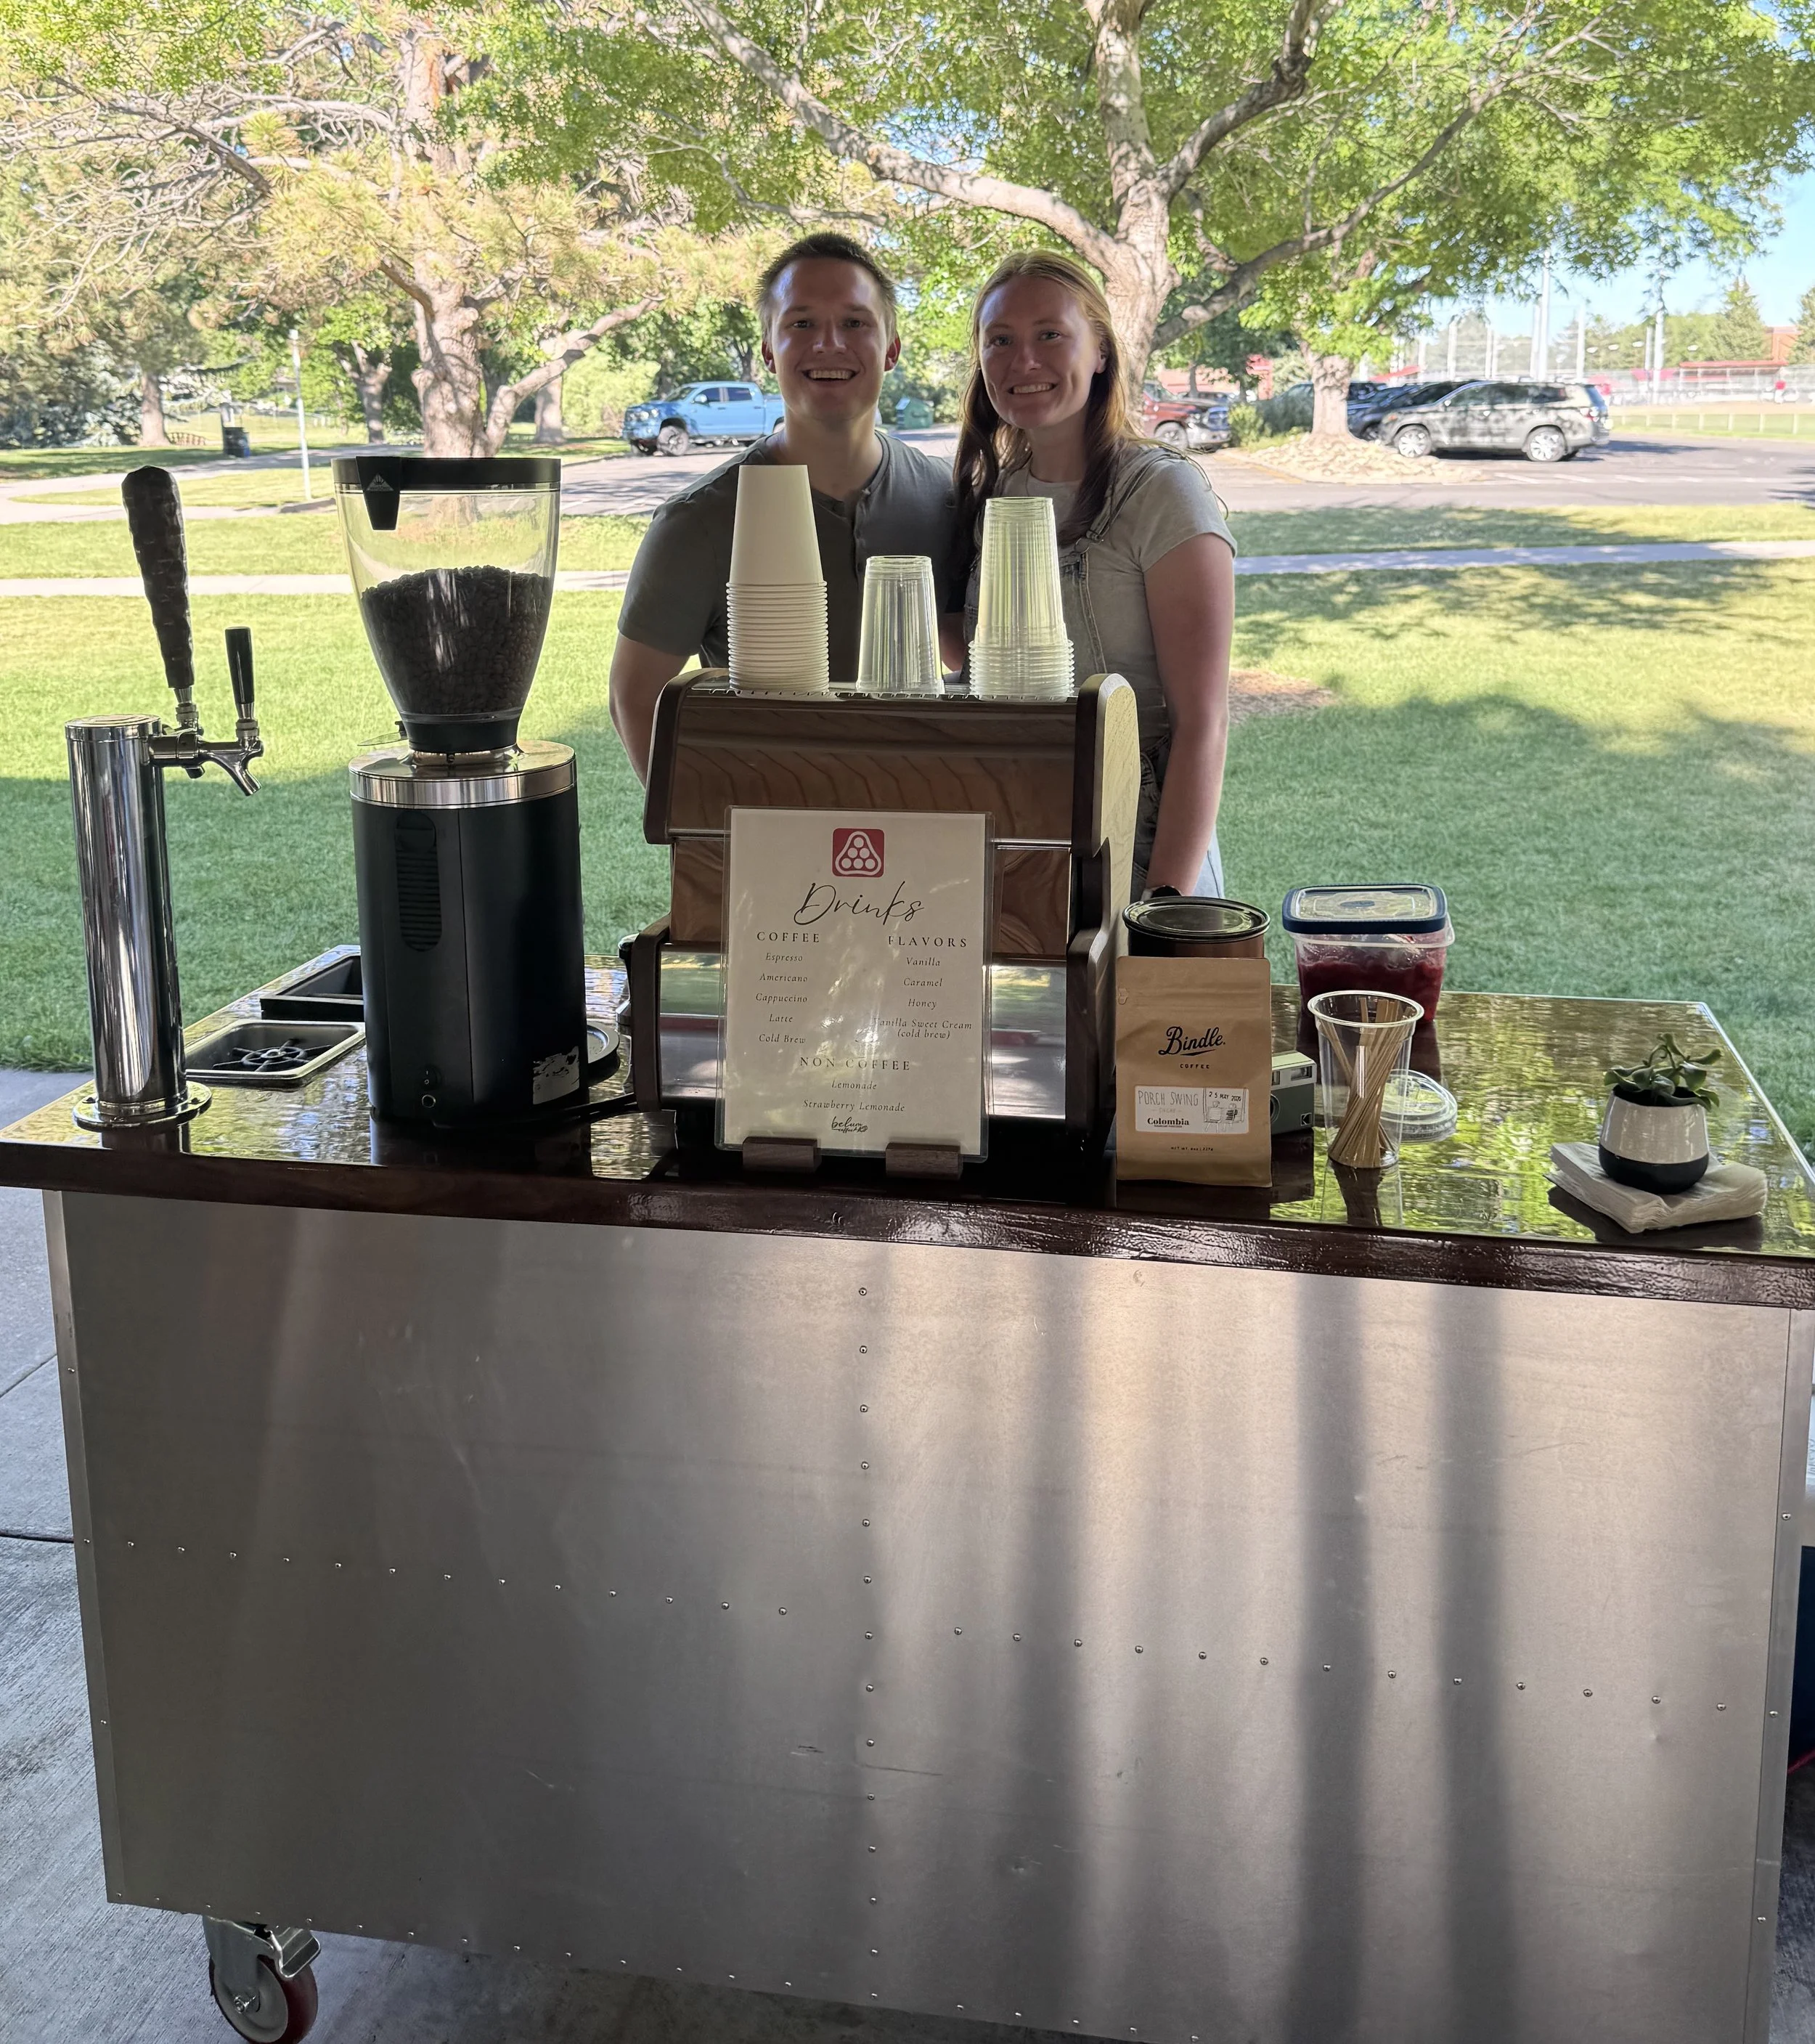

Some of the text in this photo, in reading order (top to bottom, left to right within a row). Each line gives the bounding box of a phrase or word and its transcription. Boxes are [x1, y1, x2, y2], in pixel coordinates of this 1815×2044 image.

[794, 881, 924, 926] Drinks
[756, 932, 820, 943] COFFEE
[888, 935, 968, 948] FLAVORS
[765, 953, 803, 963] Espresso
[906, 957, 941, 967] Vanilla
[759, 973, 808, 983] Americano
[903, 978, 942, 988] Caramel
[756, 993, 808, 1004] Cappuccino
[908, 998, 937, 1009] Honey
[769, 1014, 794, 1023] Latte
[911, 1019, 938, 1027] Sweet
[942, 1020, 972, 1030] Cream
[759, 1034, 806, 1044] Cold Brew
[897, 1028, 951, 1040] (cold brew)
[799, 1056, 910, 1071] NON COFFEE
[831, 1080, 877, 1091] Lemonade
[1138, 1090, 1199, 1107] PORCH SWING
[803, 1099, 905, 1112] Strawberry Lemonade
[1147, 1117, 1190, 1125] Colombia
